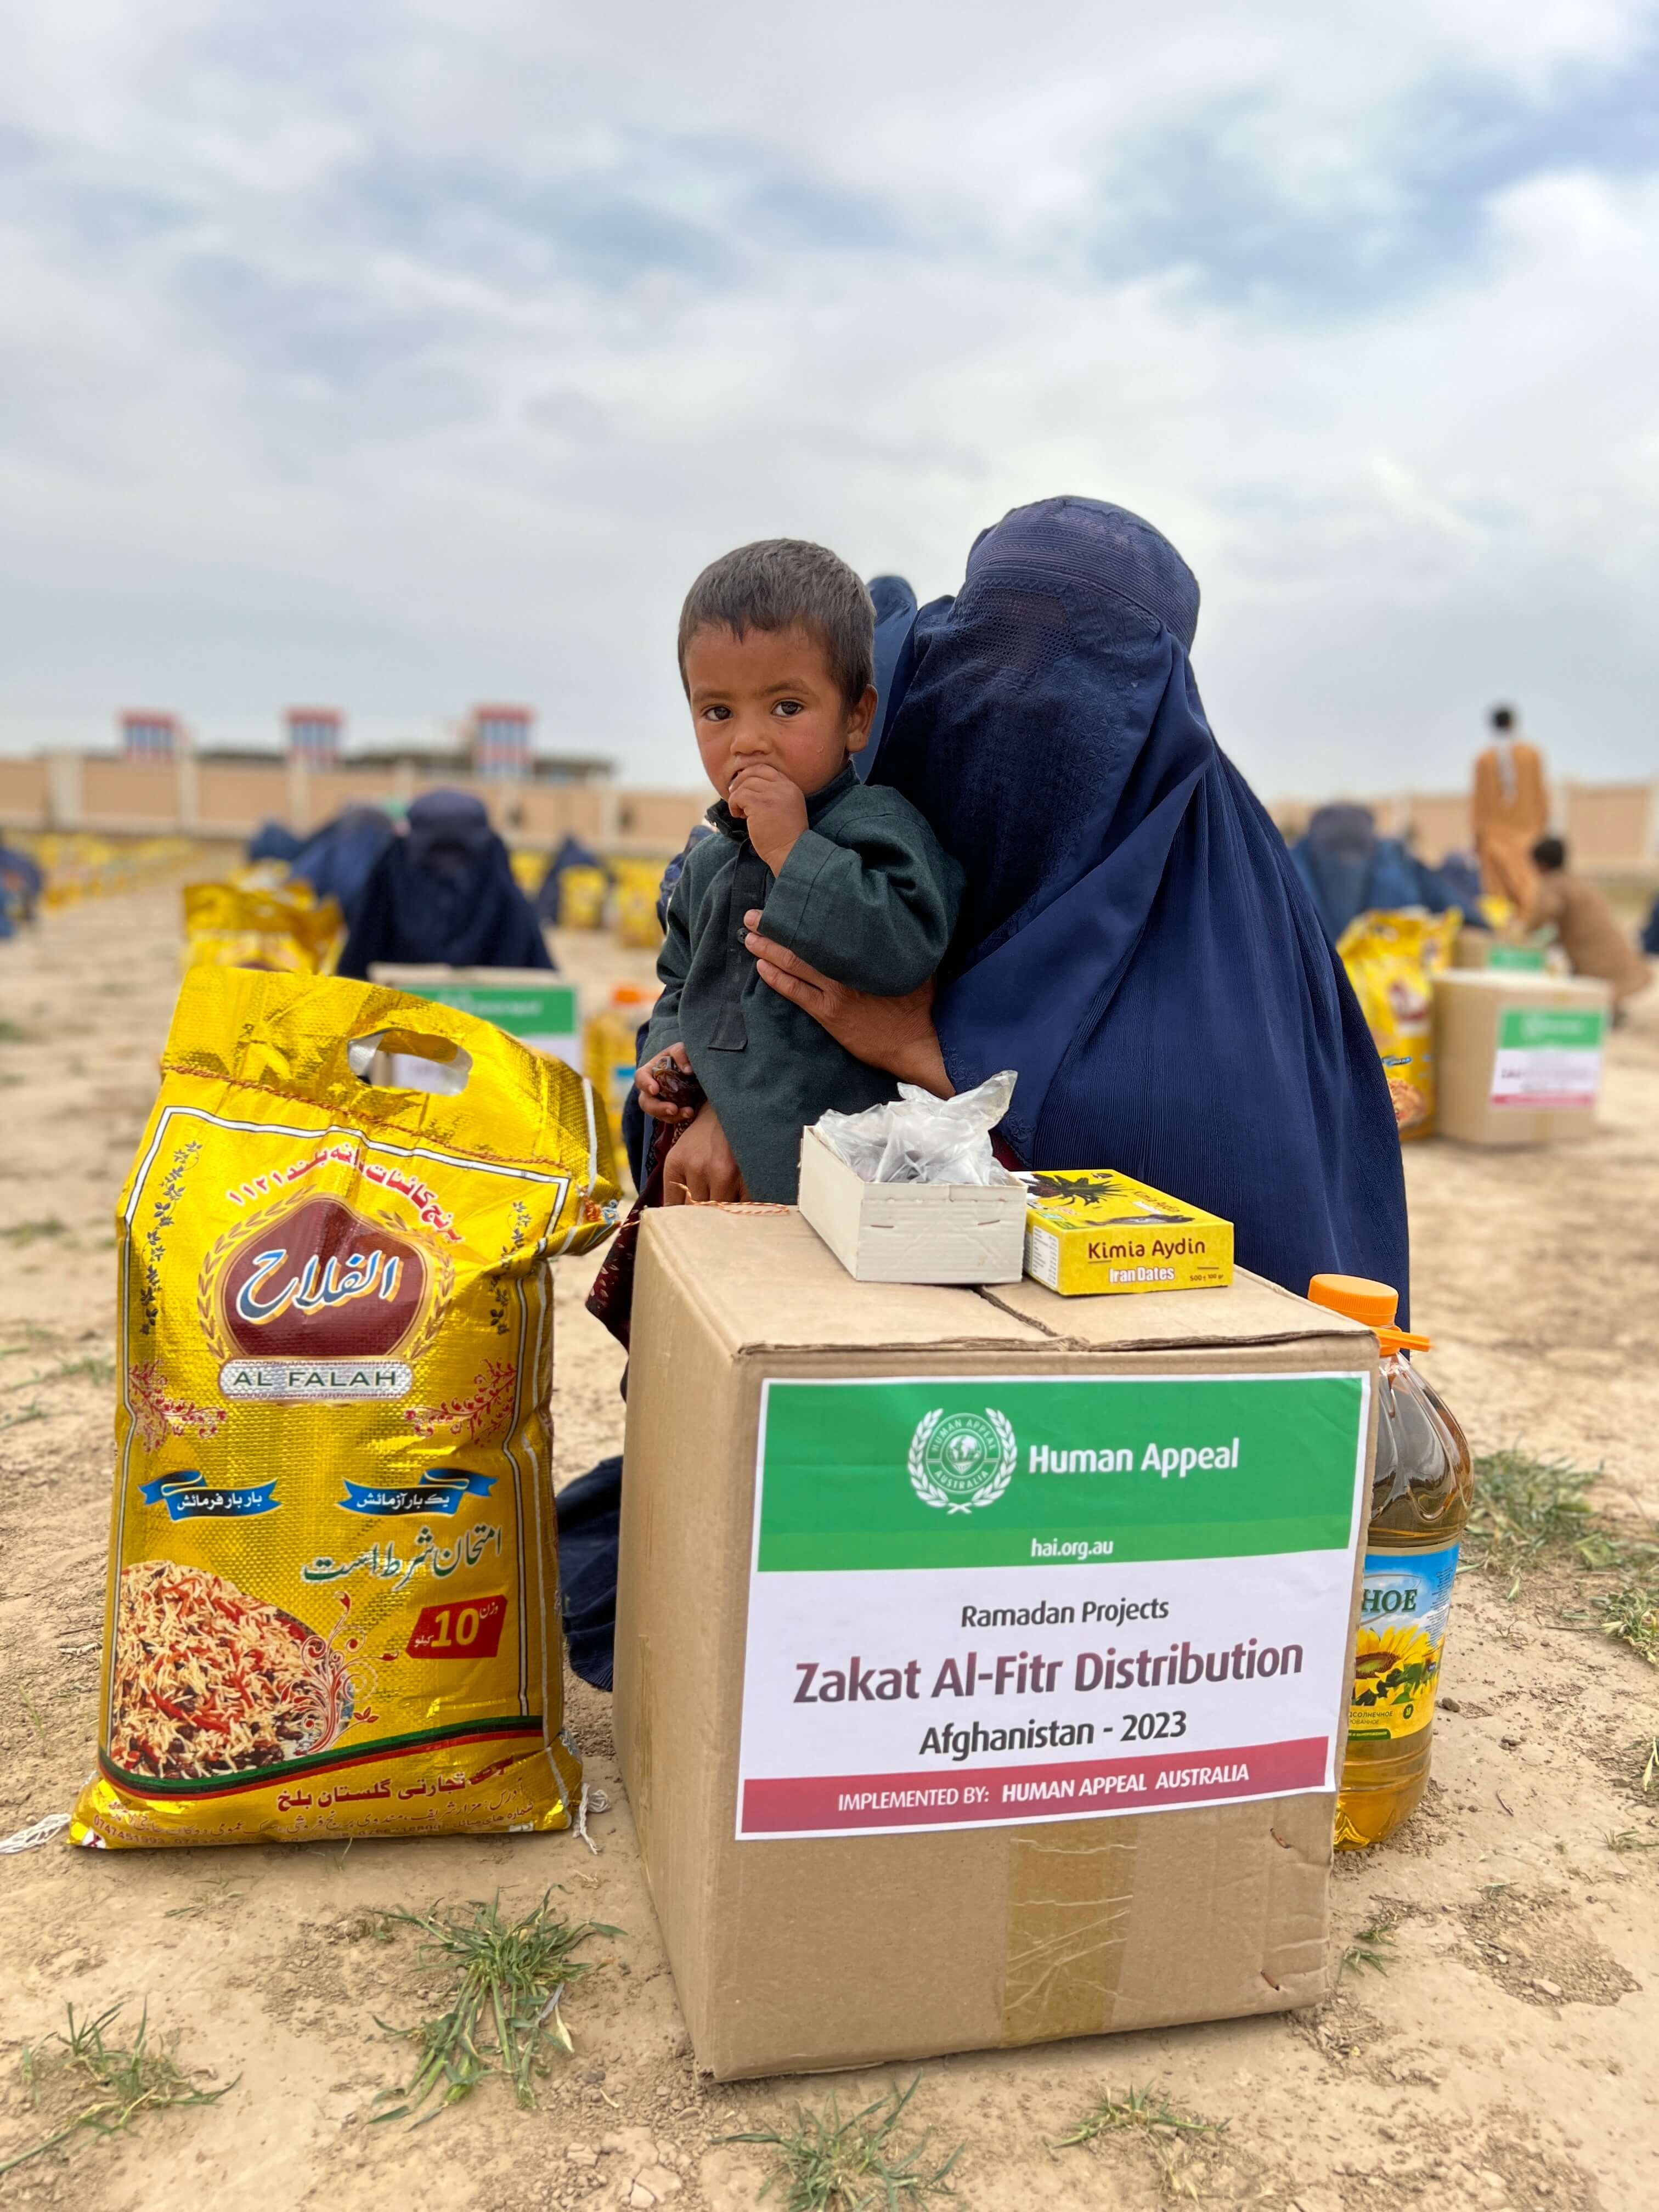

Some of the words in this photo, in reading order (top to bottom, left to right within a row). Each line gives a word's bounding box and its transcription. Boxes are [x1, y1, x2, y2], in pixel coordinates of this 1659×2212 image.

[1088, 1241, 1145, 1259] Kimia
[1152, 1238, 1205, 1260] Aydin
[236, 1249, 403, 1324] الفلاح
[1109, 1268, 1136, 1283] Iran
[1137, 1266, 1175, 1282] Dates
[233, 1370, 273, 1387] AL
[289, 1370, 396, 1387] FALAH
[932, 1419, 962, 1452] HUMAN
[966, 1418, 996, 1451] APPEAL
[1029, 1444, 1133, 1474] Human
[1141, 1437, 1240, 1479] Appeal
[934, 1470, 989, 1489] AUSTRALIA
[224, 1492, 243, 1509] بار
[244, 1491, 263, 1507] بار
[405, 1494, 423, 1509] بار
[301, 1542, 380, 1583] است
[1030, 1538, 1114, 1560] hai.org.au
[431, 1607, 480, 1647] 10
[961, 1600, 1075, 1627] Ramadan
[1082, 1597, 1169, 1627] Projects
[793, 1656, 921, 1703] Zakat
[930, 1650, 1064, 1699] Al-Fitr
[1075, 1637, 1304, 1692] Distribution
[919, 1718, 1095, 1761] Afghanistan
[1120, 1711, 1187, 1741] 2023
[277, 1788, 313, 1812] بلخ
[318, 1778, 392, 1808] گلستان
[838, 1787, 959, 1811] IMPLEMENTED
[963, 1786, 989, 1804] BY:
[1002, 1780, 1075, 1802] HUMAN
[1079, 1773, 1147, 1796] APPEAL
[1155, 1763, 1249, 1790] AUSTRALIA
